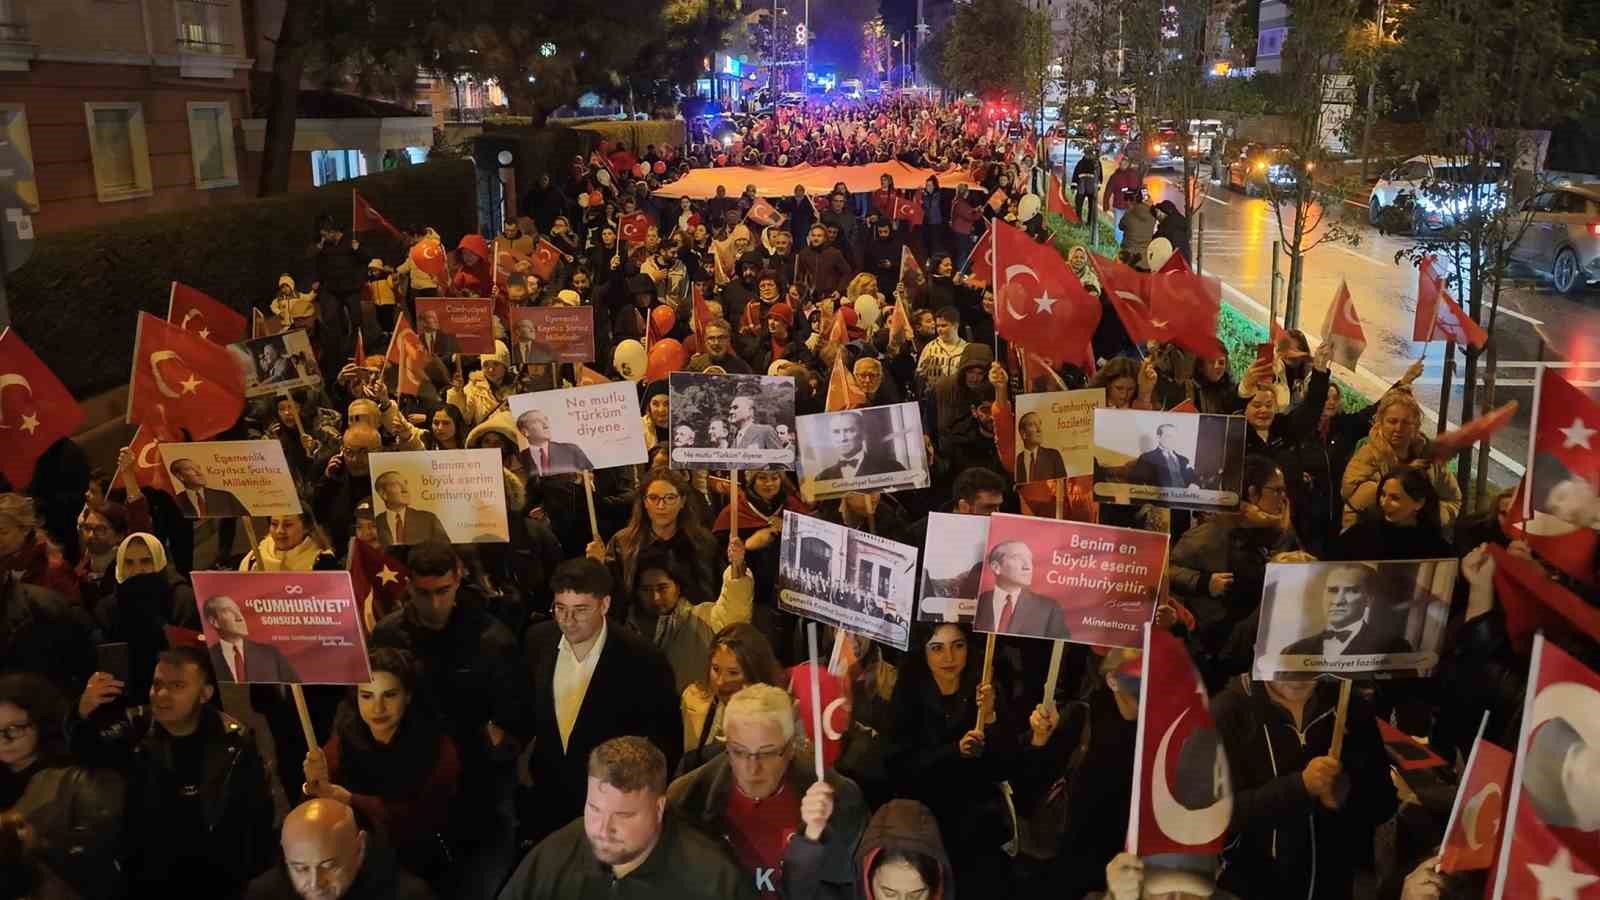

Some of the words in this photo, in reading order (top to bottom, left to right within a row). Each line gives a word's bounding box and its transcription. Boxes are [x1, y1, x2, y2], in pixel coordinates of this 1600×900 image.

[566, 397, 586, 409] Ne
[590, 391, 625, 406] mutlu
[1051, 400, 1099, 415] Cumhuriyet
[577, 422, 625, 437] diyene.
[431, 460, 464, 471] Benim
[467, 461, 481, 470] en
[422, 474, 455, 487] büyük
[457, 472, 494, 485] eserim
[1070, 534, 1114, 553] Benim
[1119, 543, 1137, 555] en
[1052, 550, 1096, 570] büyük
[1100, 559, 1148, 576] eserim
[1046, 570, 1147, 596] Cumhuriyettir.
[245, 596, 351, 614] "CUMHURİYET"
[261, 615, 301, 625] SONSUZA
[303, 615, 342, 626] KADAR...
[1303, 657, 1354, 670] Cumhuriyet
[755, 867, 776, 892] K
